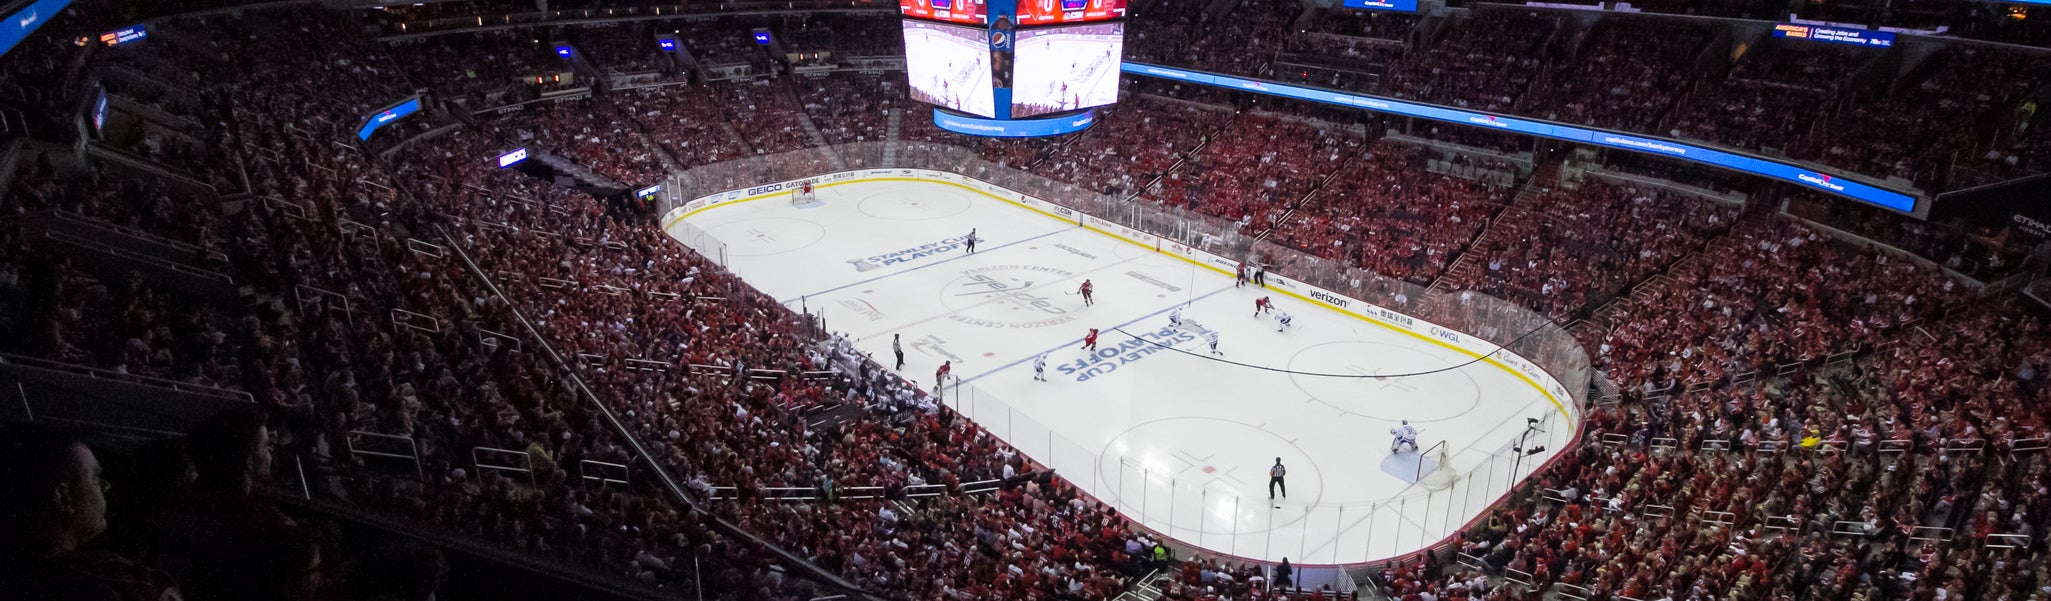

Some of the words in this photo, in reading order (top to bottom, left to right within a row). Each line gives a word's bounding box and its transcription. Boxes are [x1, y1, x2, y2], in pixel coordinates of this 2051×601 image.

[1815, 28, 1836, 36] Creating
[1843, 35, 1867, 44] Economy
[748, 183, 783, 196] GEICO
[1060, 207, 1072, 216] CSN
[868, 242, 938, 263] STANLEY
[960, 264, 1020, 276] VERIZON
[1023, 265, 1074, 277] CENTER
[1310, 289, 1348, 308] verizon
[948, 314, 1006, 330] CENTER
[1008, 315, 1077, 329] VERIZON
[1440, 329, 1460, 343] WGL
[1056, 326, 1177, 375] PLAYOFFS
[1120, 331, 1196, 366] STANLEY
[1076, 361, 1118, 382] CUP
